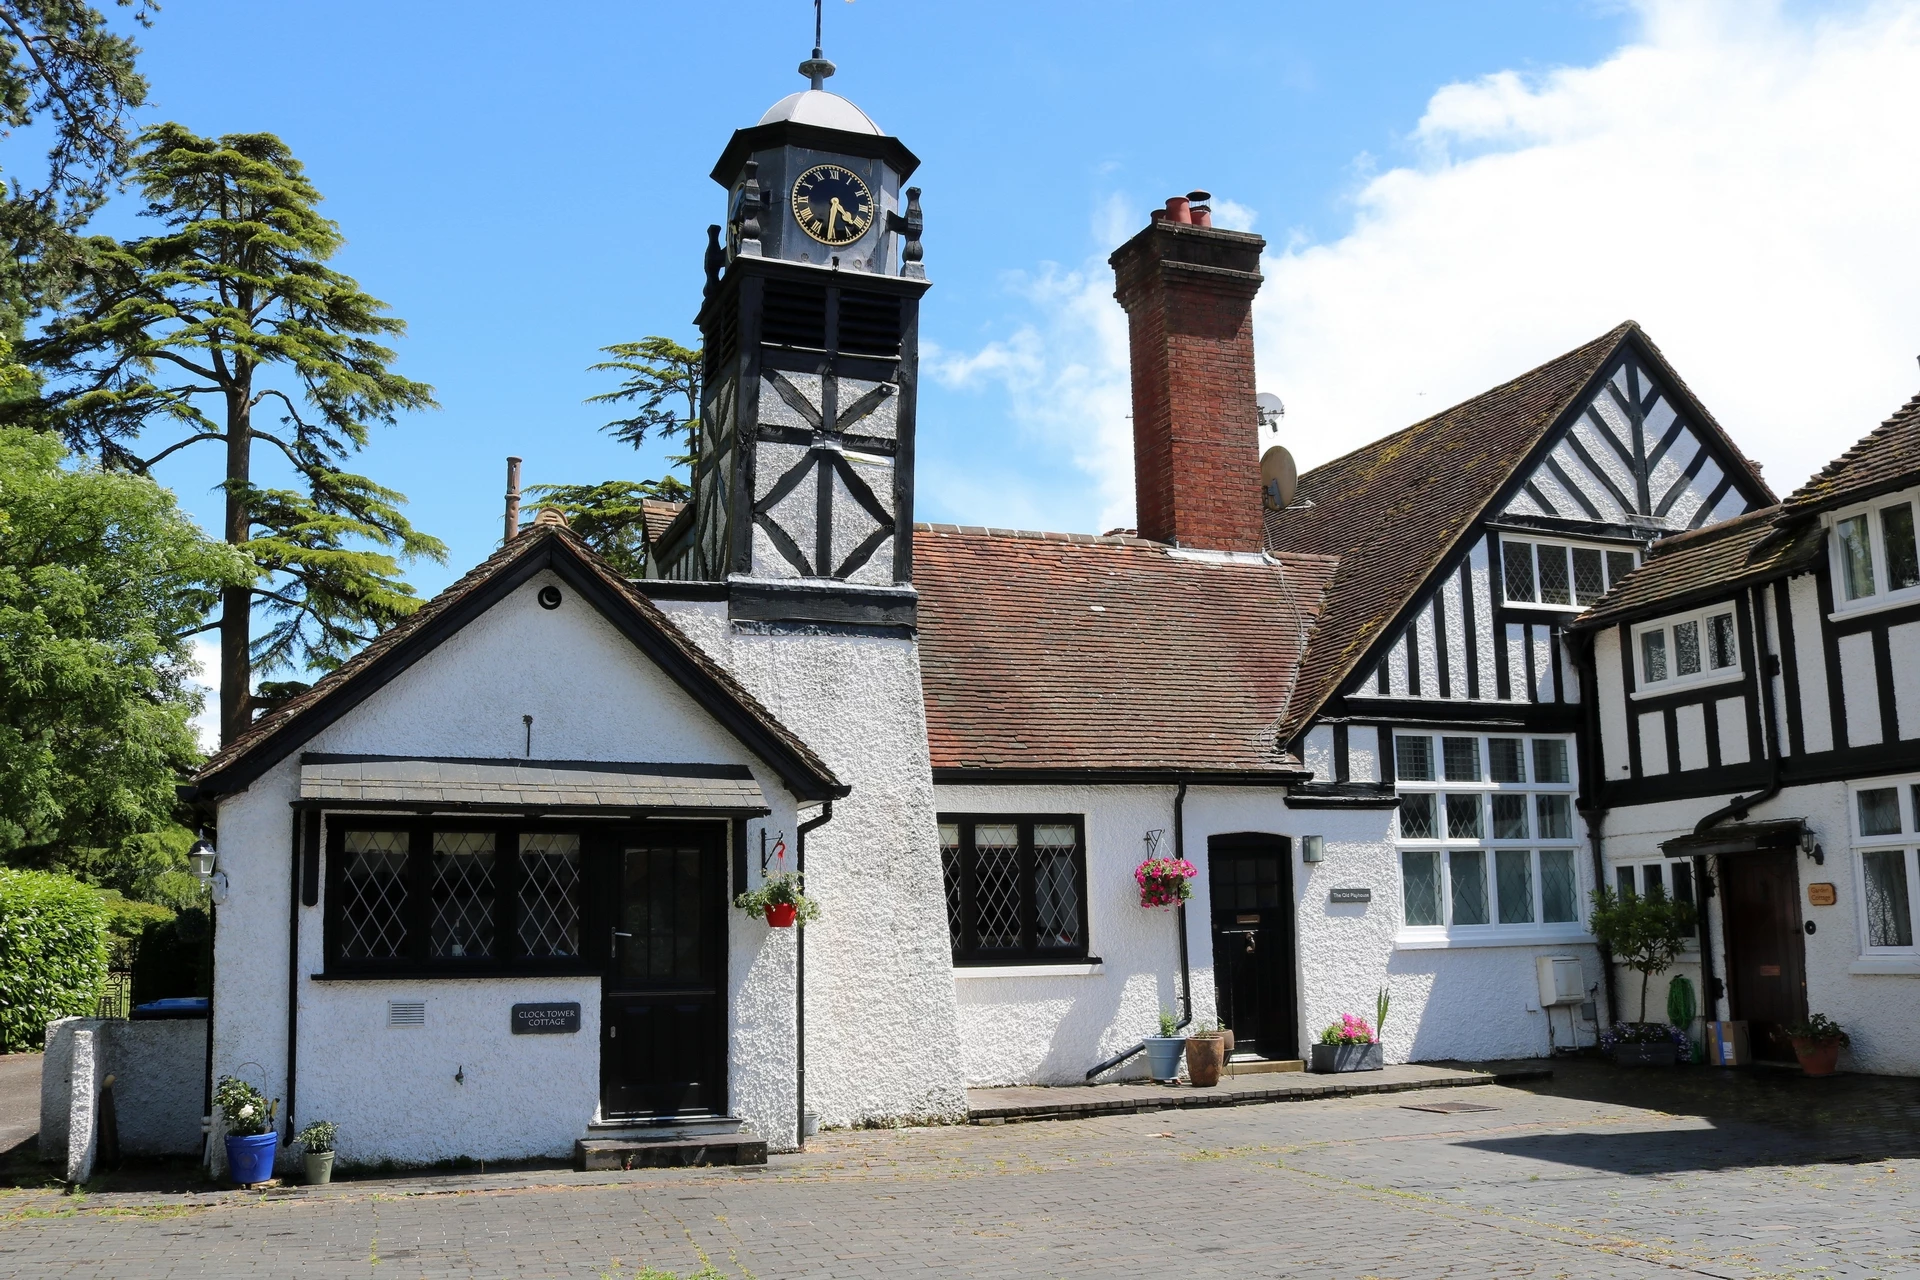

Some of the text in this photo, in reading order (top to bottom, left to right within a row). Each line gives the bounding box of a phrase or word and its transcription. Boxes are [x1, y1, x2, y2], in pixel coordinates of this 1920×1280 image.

[813, 171, 825, 182] XI
[830, 170, 840, 180] XII
[802, 181, 813, 190] X
[846, 177, 852, 185] I
[798, 195, 808, 203] IX
[859, 204, 868, 213] III
[800, 207, 814, 222] VIII
[811, 220, 823, 234] VII
[844, 226, 852, 237] V
